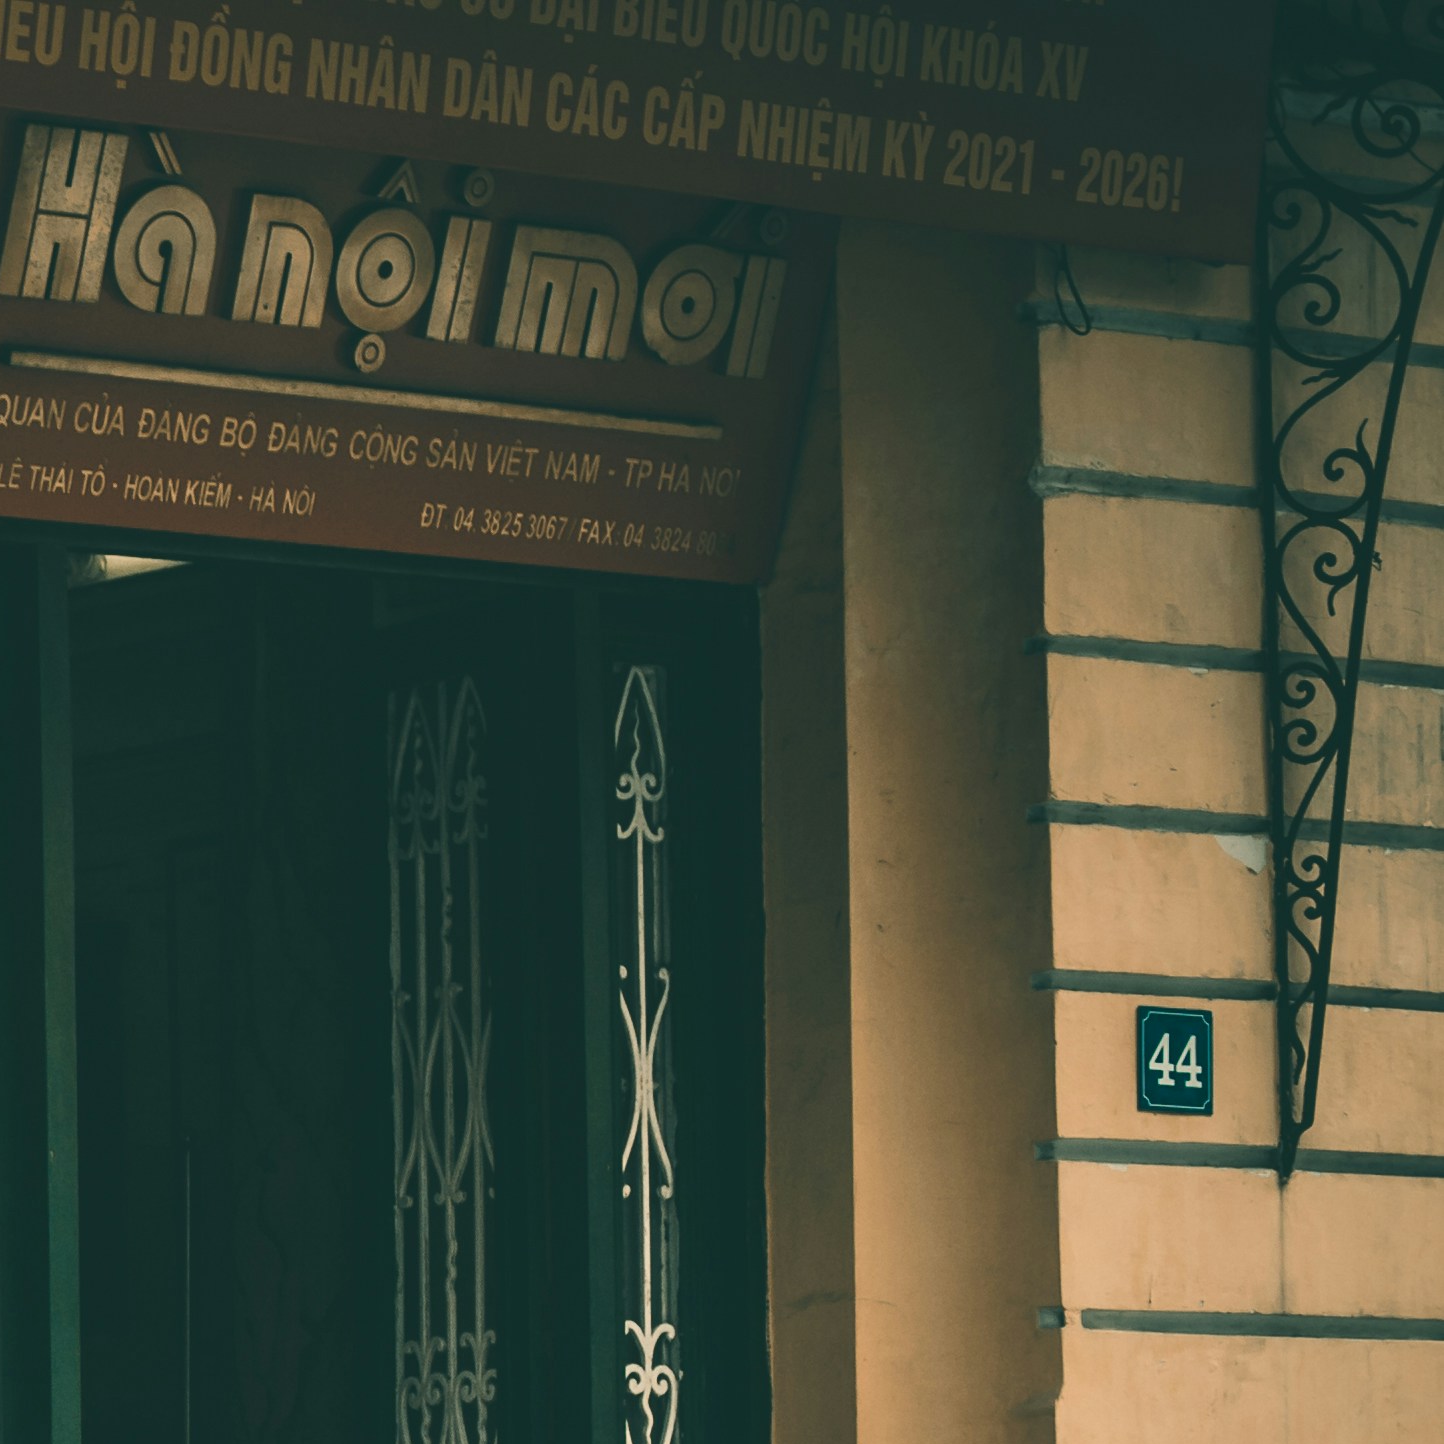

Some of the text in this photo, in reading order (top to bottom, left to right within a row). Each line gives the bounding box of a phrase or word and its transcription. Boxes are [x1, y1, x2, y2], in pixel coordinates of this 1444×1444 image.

[841, 3, 910, 89] HỘI
[920, 20, 1024, 95] KHÓA
[1035, 40, 1090, 102] XV
[78, 0, 157, 89] HỘI
[168, 3, 294, 95] ĐỒNG
[306, 34, 431, 113] NHÂN
[443, 49, 533, 127] DÂN
[545, 64, 630, 140] CÁC
[642, 70, 726, 152] CẤP
[737, 97, 872, 181] NHIỆM
[882, 110, 935, 182] KỲ
[943, 129, 1035, 196] 2021
[1051, 168, 1065, 181] -
[1076, 147, 1185, 213] 2026!
[231, 160, 493, 374] nội
[74, 392, 124, 436] CỦA
[220, 411, 258, 457] BỘ
[349, 423, 419, 470] CỘNG
[426, 428, 478, 472] SẢN
[487, 439, 540, 484] VIỆT
[545, 450, 601, 485] NAM
[625, 457, 654, 489] TP
[184, 471, 233, 509] KIẾM
[249, 480, 276, 513] HÀ
[481, 508, 525, 538] 3825
[525, 513, 568, 541] 3067
[651, 526, 693, 553] 3824
[1148, 1032, 1203, 1089] 44
